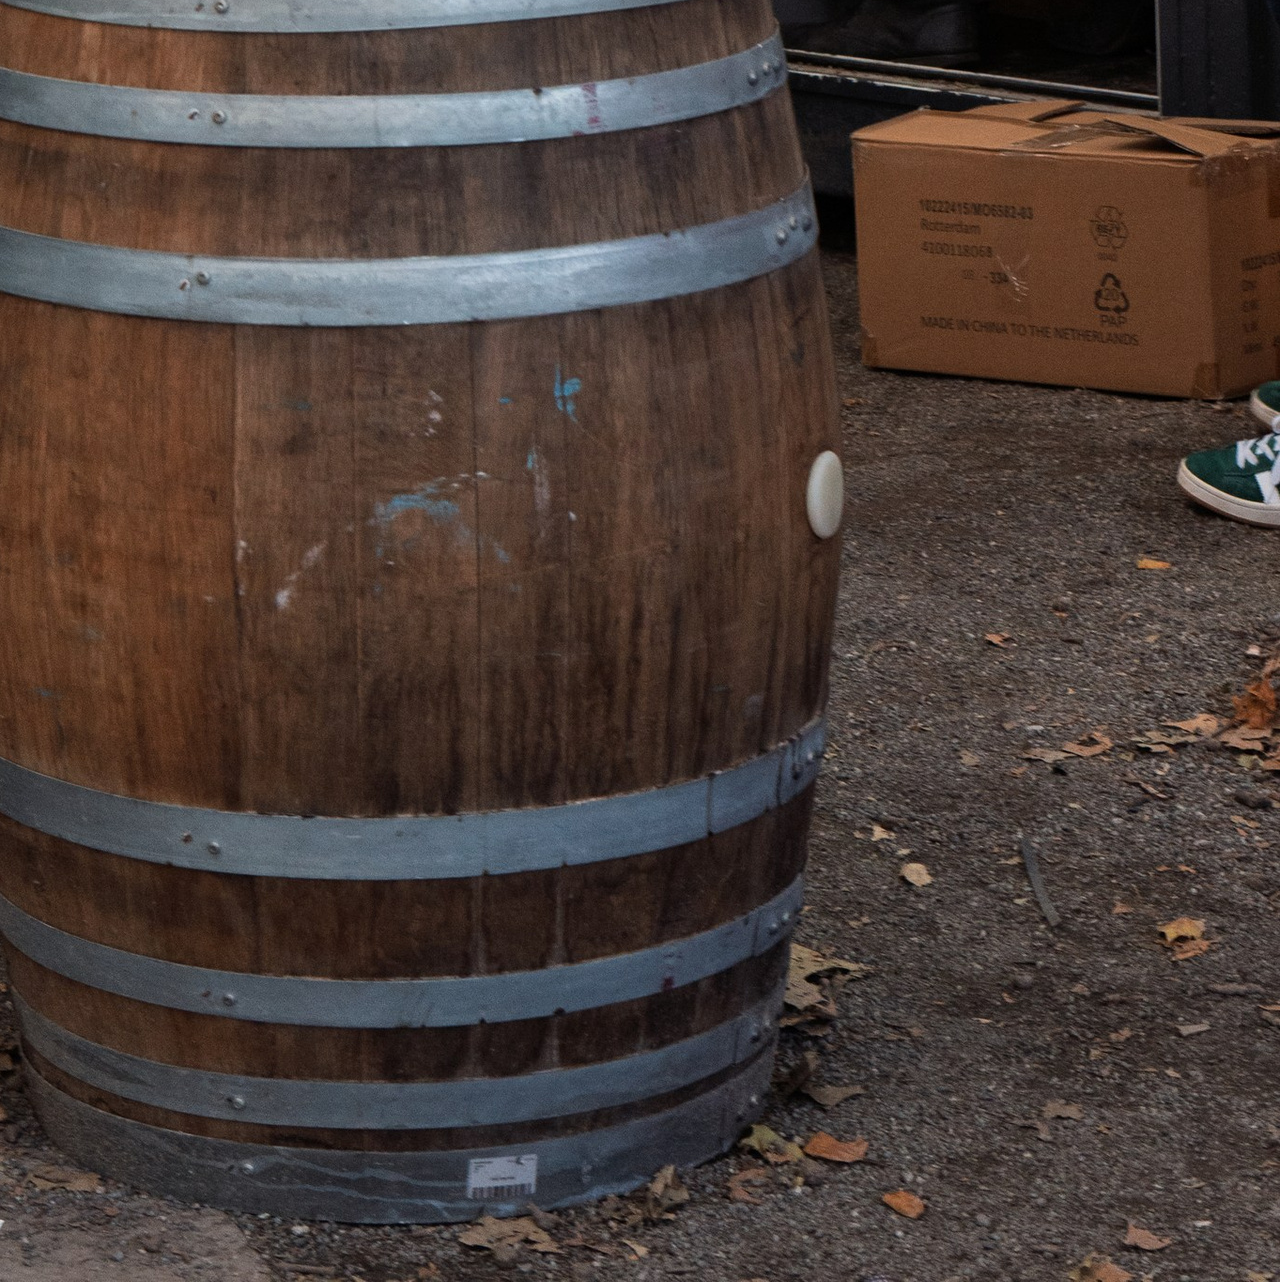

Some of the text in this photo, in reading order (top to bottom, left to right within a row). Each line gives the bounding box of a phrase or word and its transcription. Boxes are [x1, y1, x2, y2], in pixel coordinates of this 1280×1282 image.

[920, 217, 982, 235] Rotterdam
[1100, 314, 1128, 328] PAP
[920, 316, 1140, 347] MADE IN CHINA TO THE NETHERLANDS
